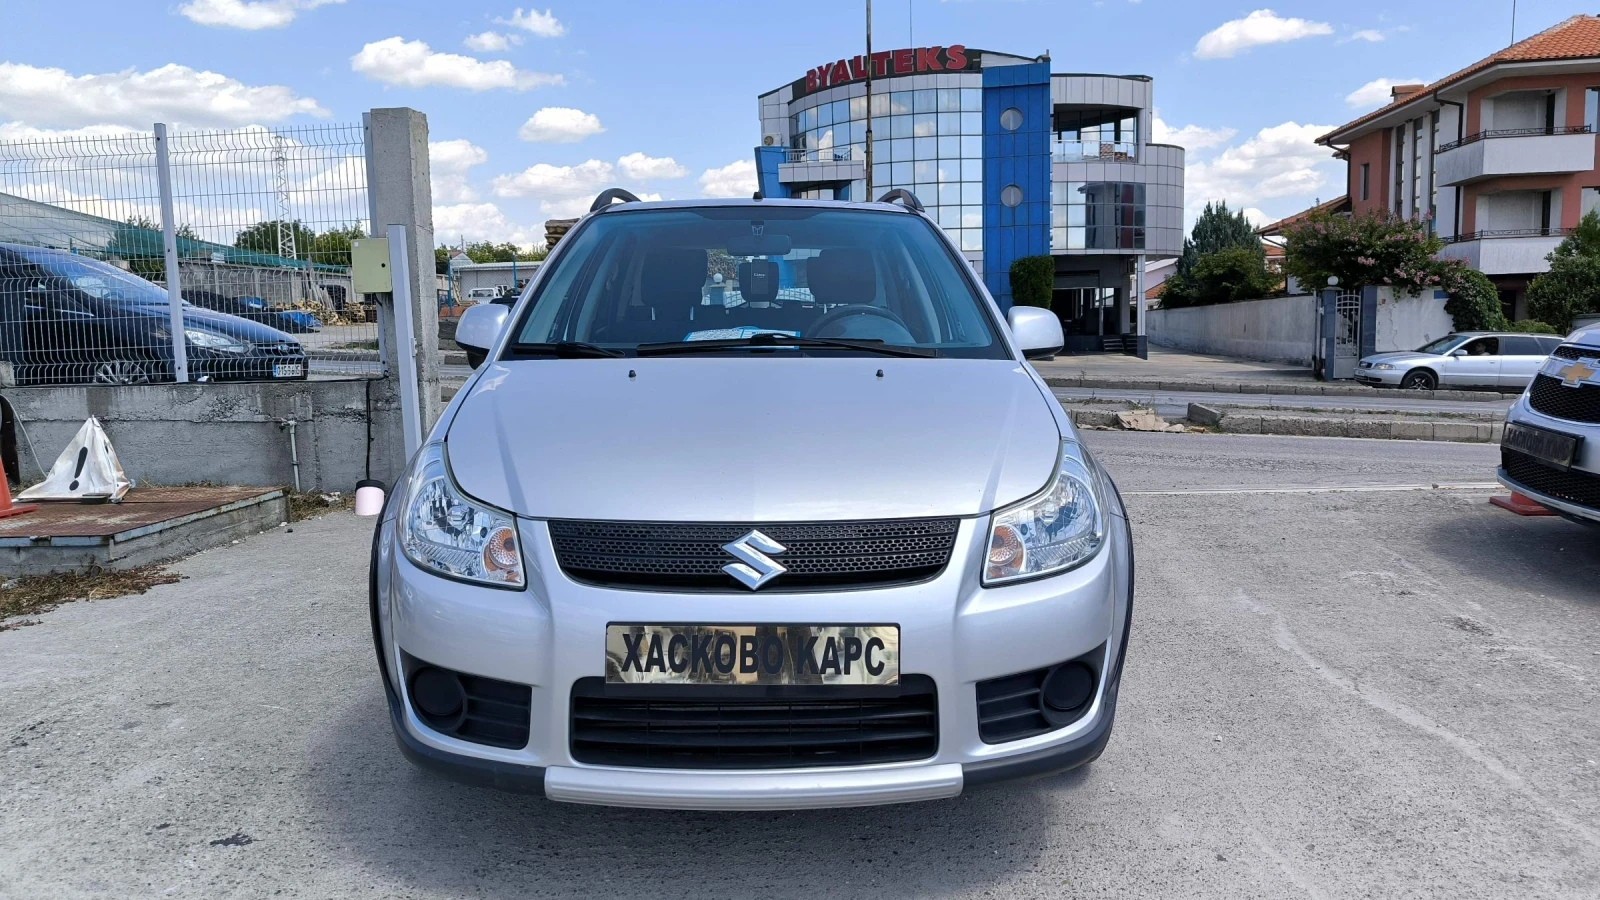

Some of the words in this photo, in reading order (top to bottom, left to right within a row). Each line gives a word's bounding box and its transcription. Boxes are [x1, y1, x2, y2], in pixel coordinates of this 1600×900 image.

[806, 44, 967, 93] BYALTEKS
[621, 633, 784, 675] ХАСКОВО
[796, 635, 885, 677] КАРС
